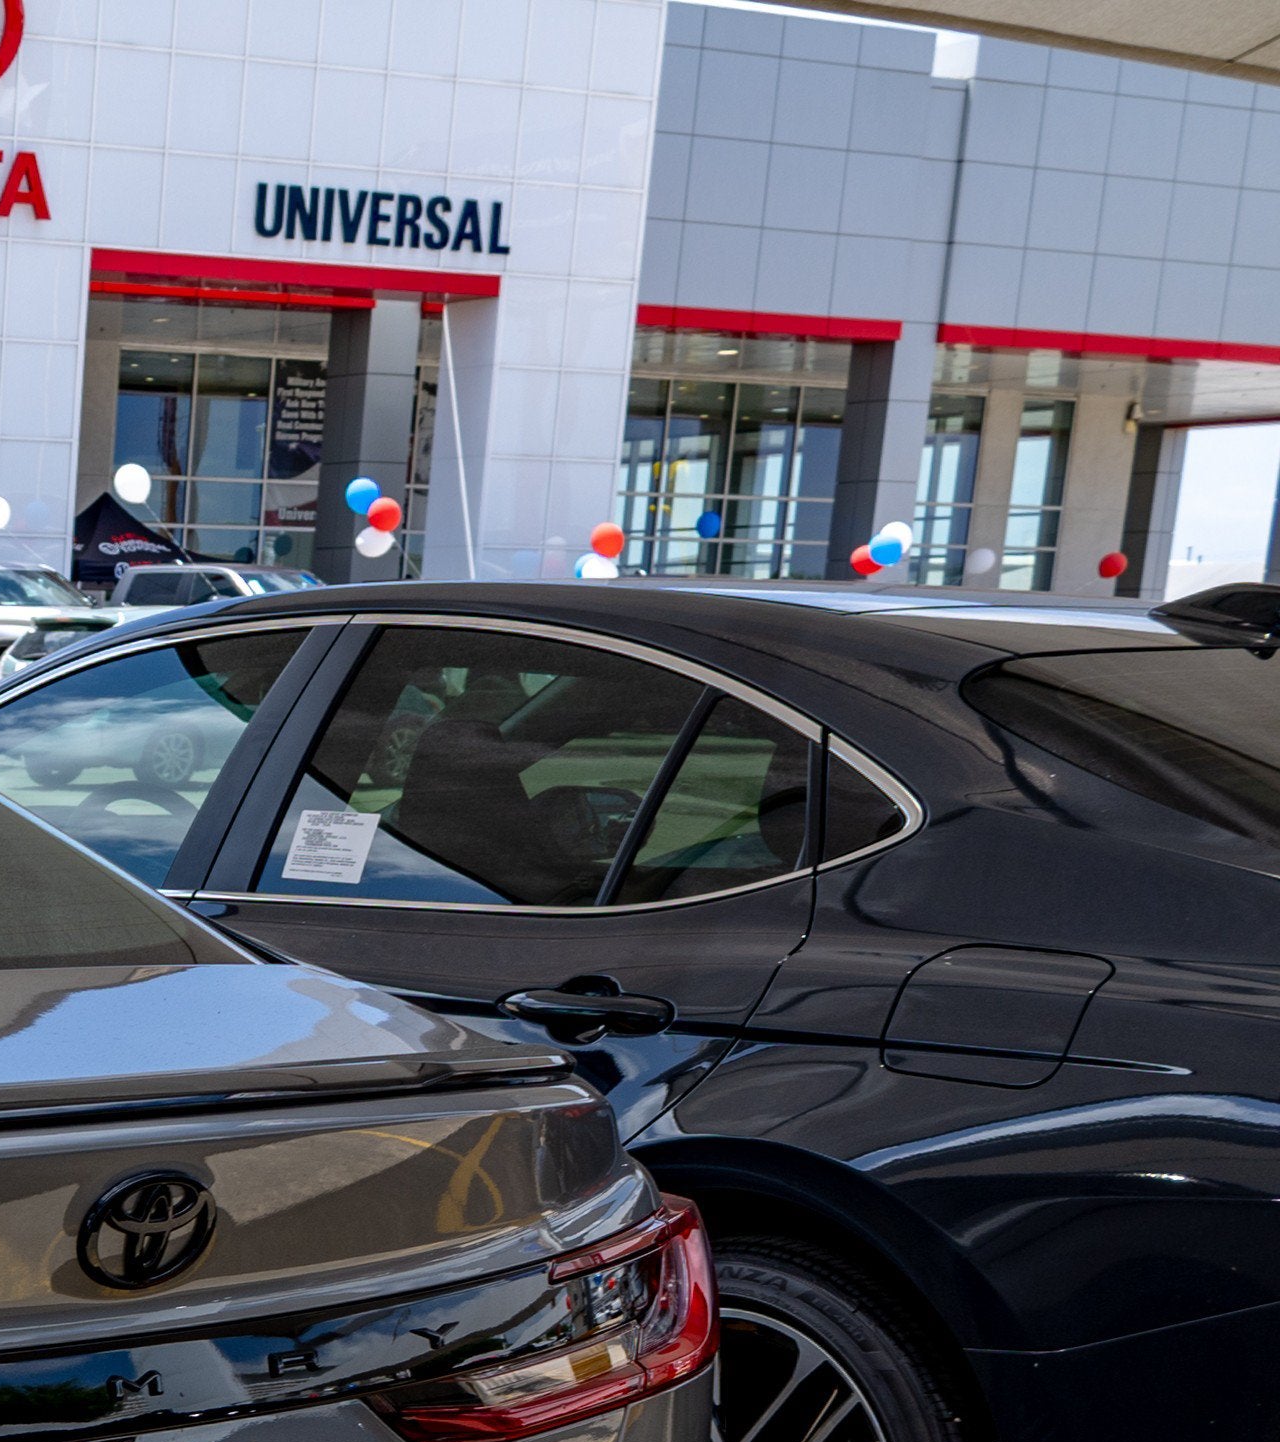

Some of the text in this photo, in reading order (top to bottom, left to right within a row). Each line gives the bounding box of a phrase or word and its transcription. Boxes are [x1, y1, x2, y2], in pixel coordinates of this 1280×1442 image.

[254, 182, 511, 255] UNIVERSAL
[295, 388, 326, 398] Respond
[277, 507, 317, 521] Univer
[719, 1265, 789, 1292] NZA
